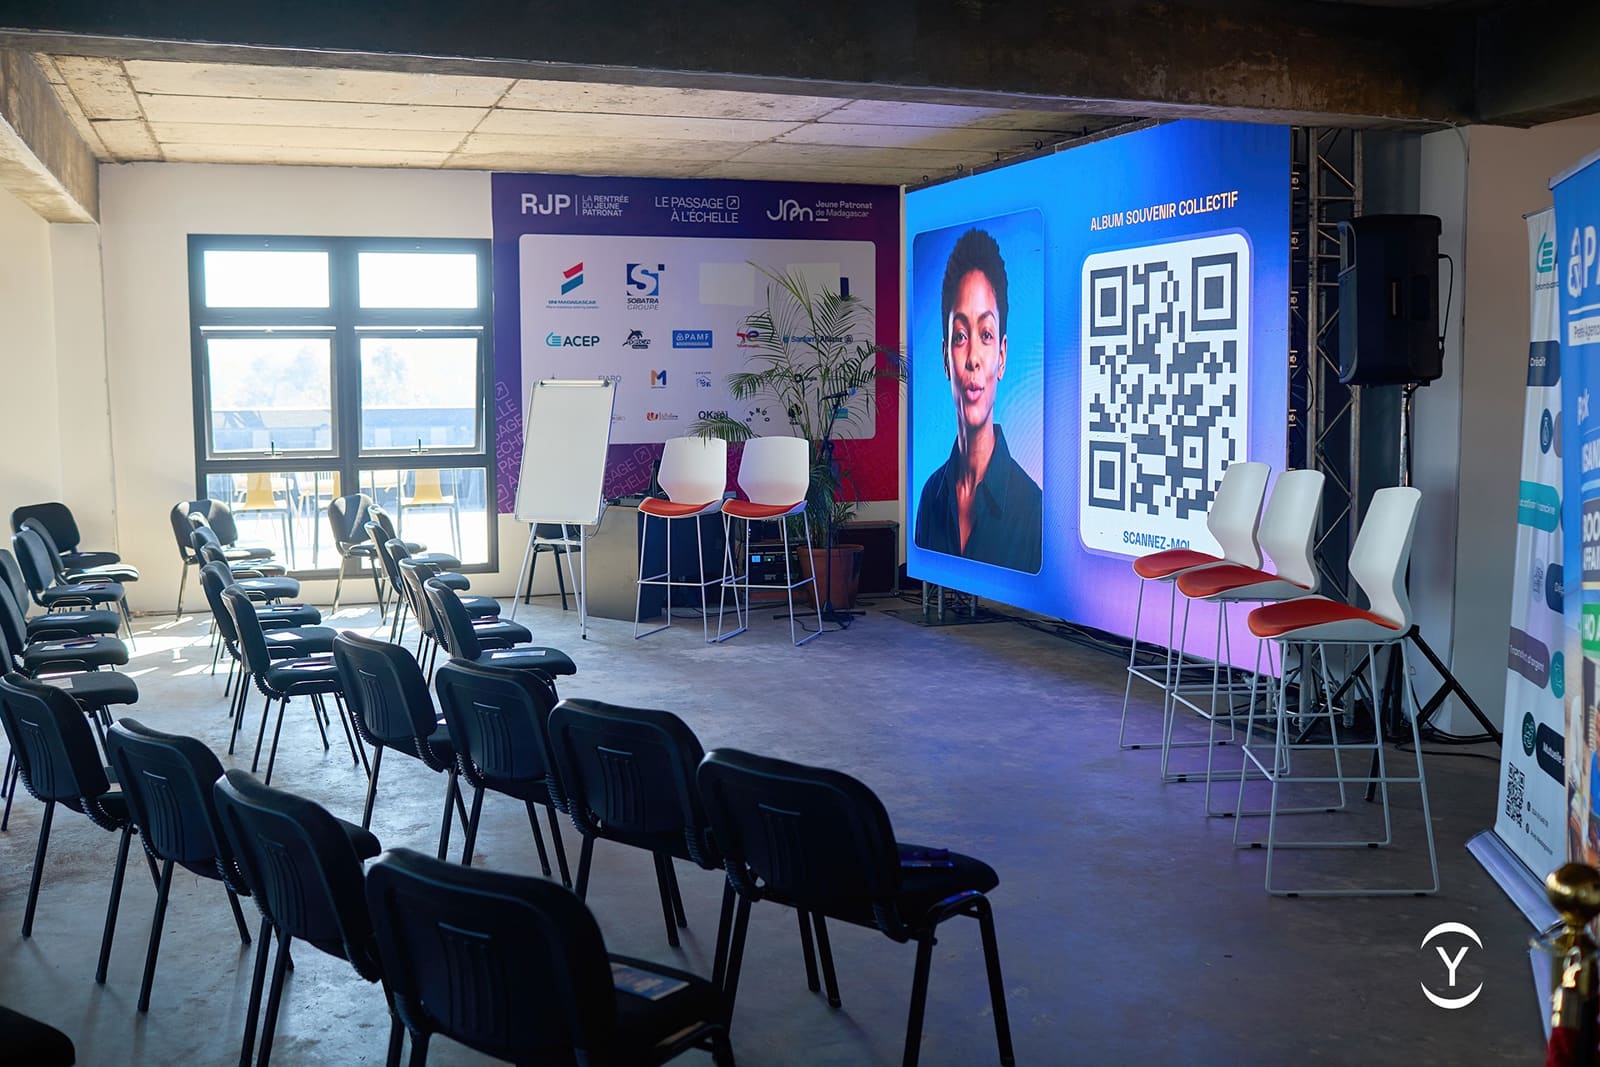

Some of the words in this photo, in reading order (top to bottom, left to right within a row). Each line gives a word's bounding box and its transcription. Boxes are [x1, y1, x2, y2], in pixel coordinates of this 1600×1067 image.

[521, 193, 571, 215] RJP
[582, 194, 592, 203] LA
[593, 194, 629, 203] RENTRÉE
[655, 196, 669, 208] LE
[671, 197, 724, 209] PASSAGE
[582, 202, 593, 210] DU
[815, 200, 838, 209] Jeune
[840, 200, 873, 210] Patronat
[582, 209, 623, 217] PATRONAT
[670, 207, 680, 222] À
[681, 208, 739, 223] L'ÉCHELLE
[815, 209, 824, 217] de
[825, 209, 869, 219] Madagascar
[1090, 212, 1124, 231] ALBUM
[1126, 203, 1177, 225] SOUVENIR
[1178, 191, 1239, 216] COLLECTIF
[563, 335, 600, 347] ACEP
[684, 333, 710, 341] PAMF
[1122, 530, 1190, 549] SCANNEZ-MOI
